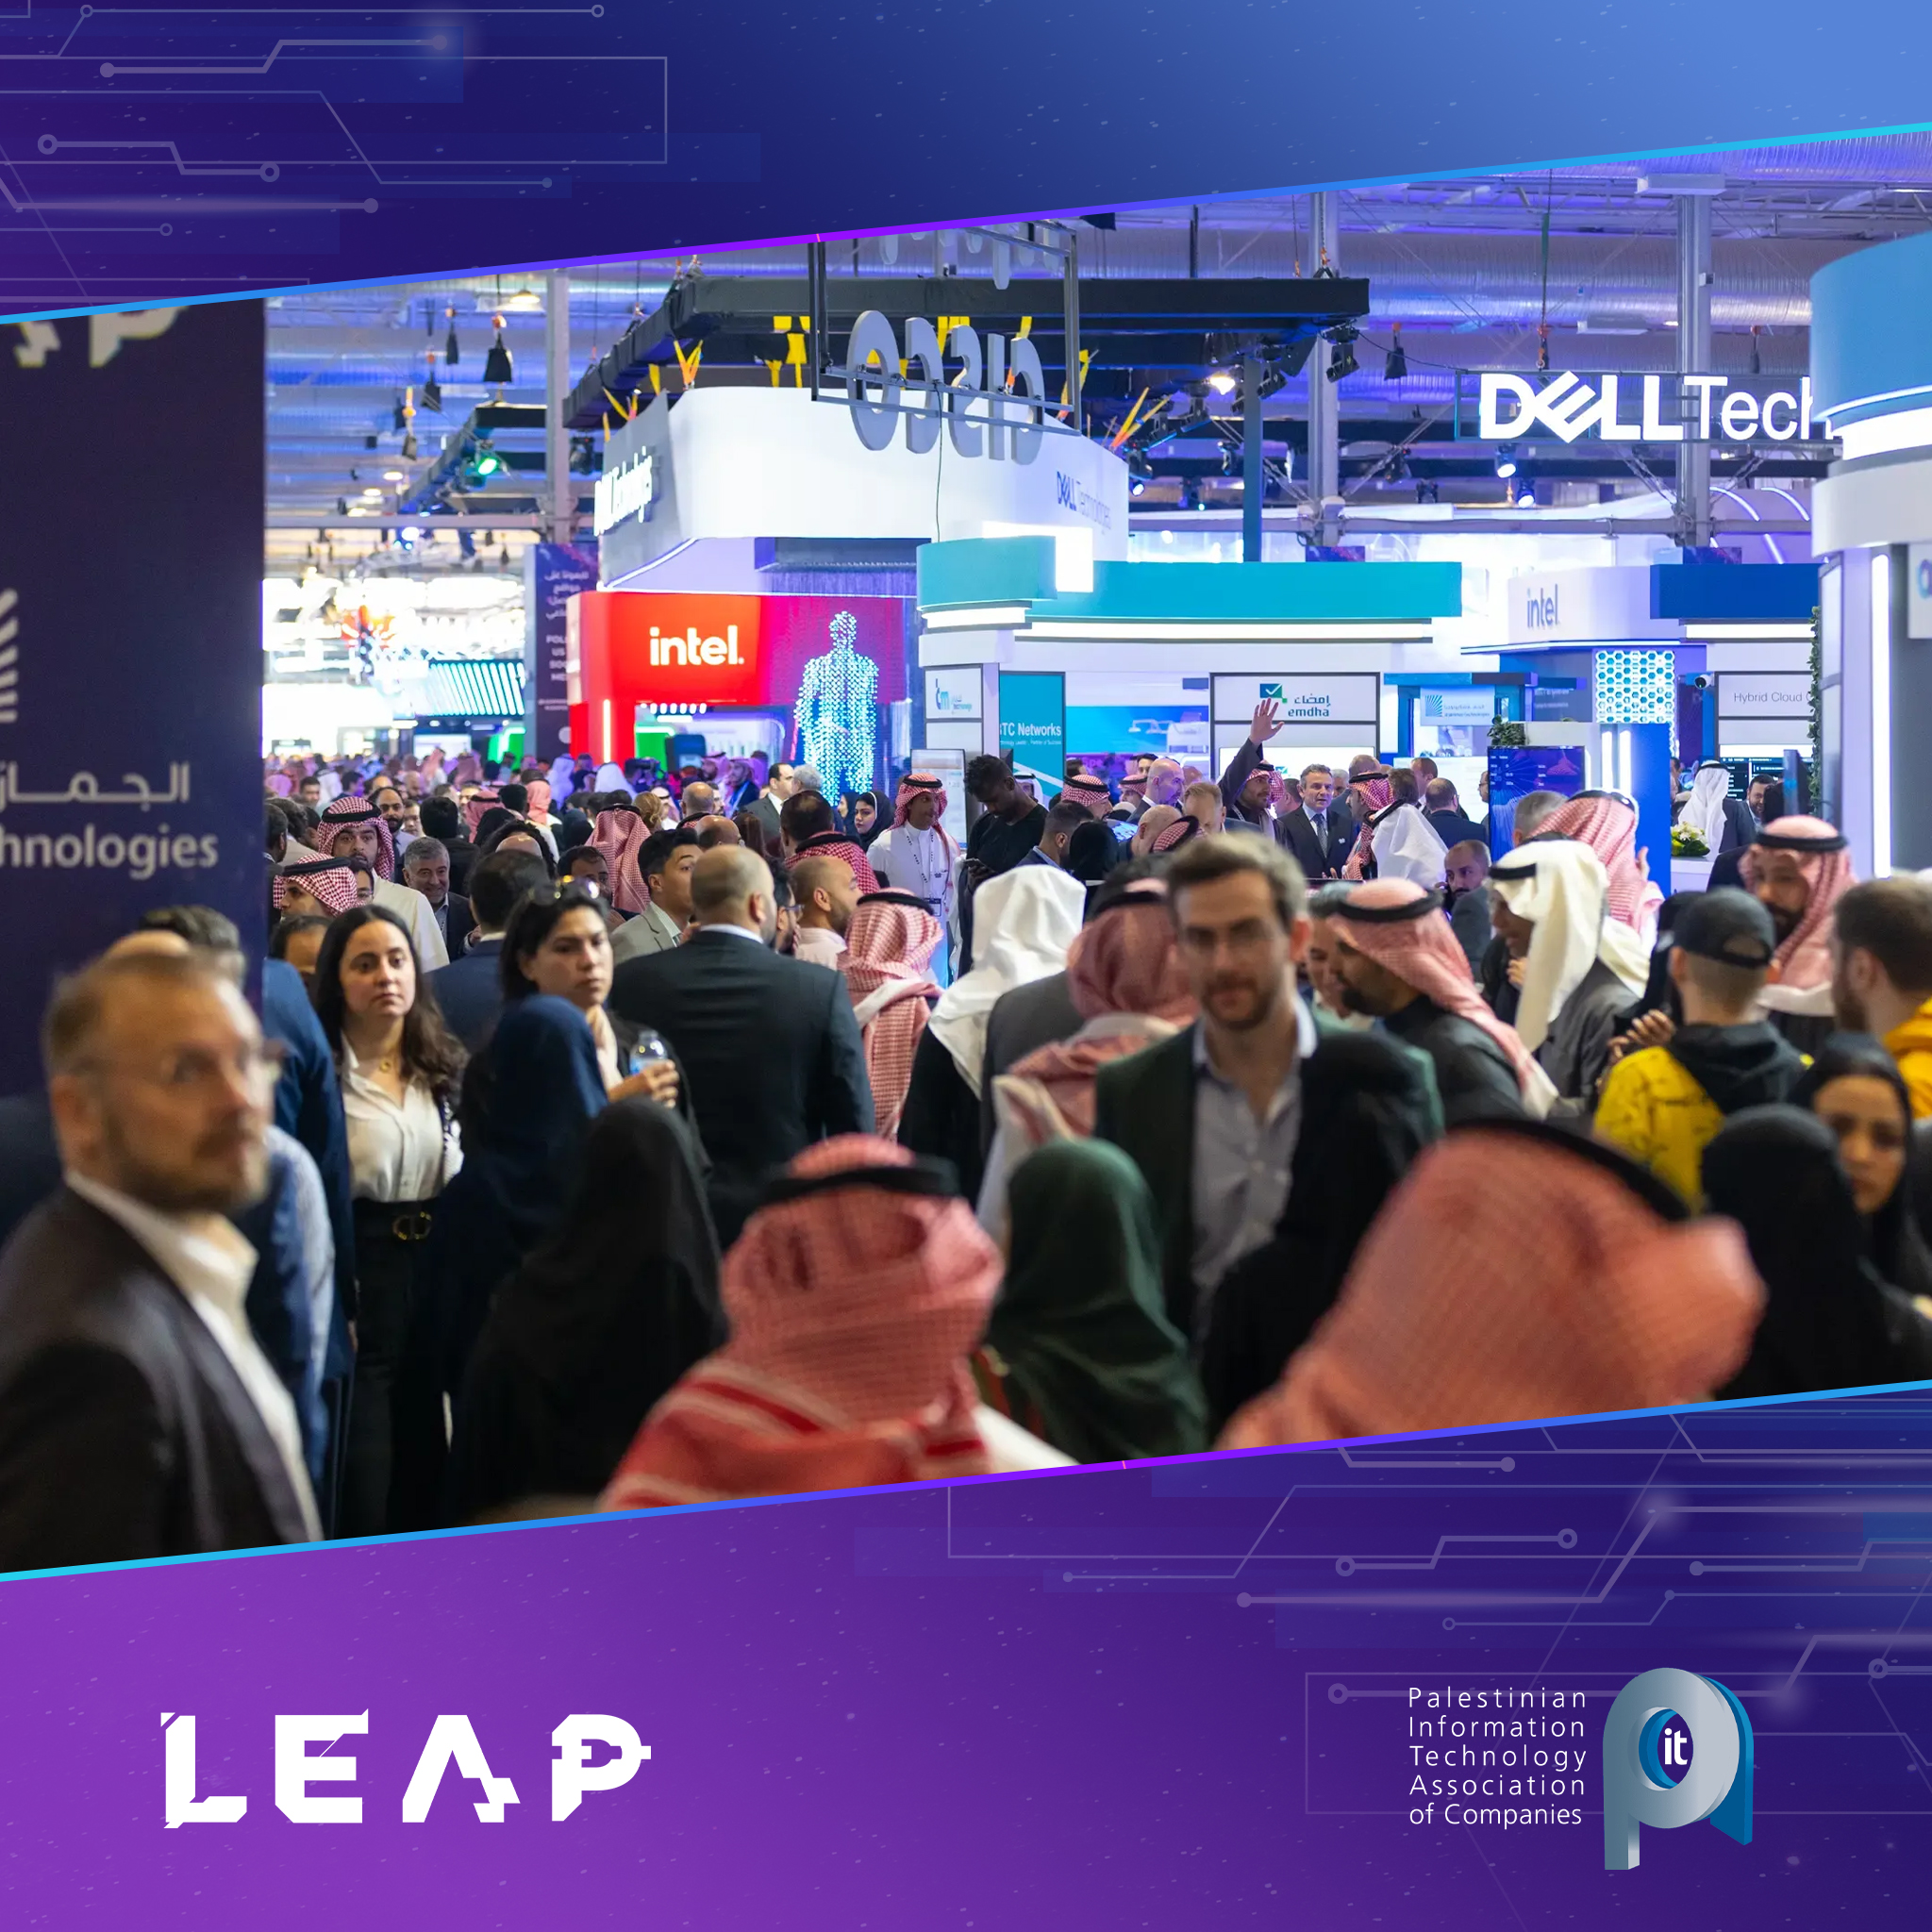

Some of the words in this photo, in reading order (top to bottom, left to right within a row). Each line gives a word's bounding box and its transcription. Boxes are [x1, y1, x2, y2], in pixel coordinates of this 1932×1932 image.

[1479, 370, 1684, 444] DELL
[1734, 692, 1768, 704] Hybrid
[1771, 691, 1803, 702] Cloud
[1288, 707, 1330, 717] emdha
[1018, 722, 1061, 736] Networks
